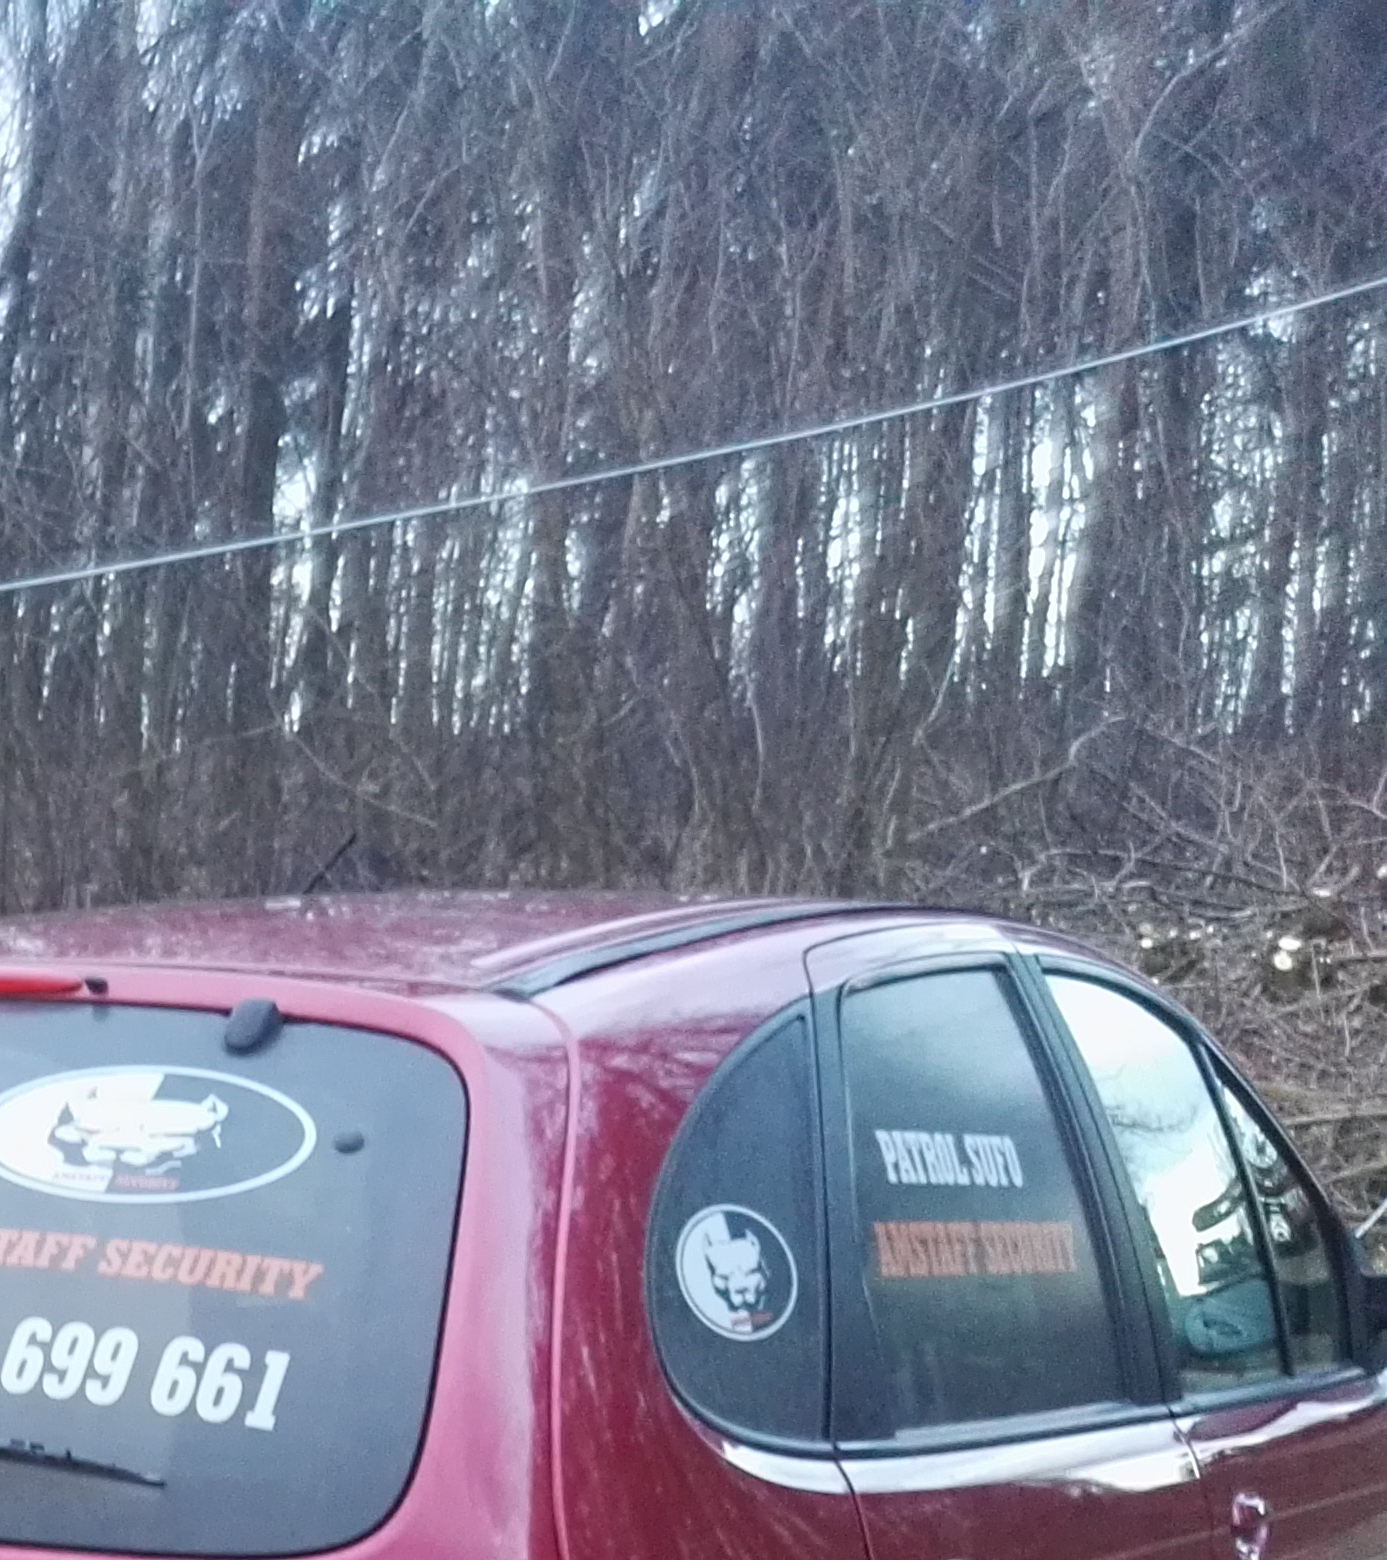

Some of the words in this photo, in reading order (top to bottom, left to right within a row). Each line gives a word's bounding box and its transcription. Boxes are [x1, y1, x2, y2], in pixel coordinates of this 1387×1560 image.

[874, 1129, 972, 1186] PATROL
[963, 1133, 1024, 1188] SUFO
[96, 1239, 325, 1300] SECURITY
[0, 1316, 139, 1406] 699
[149, 1335, 291, 1432] 661
